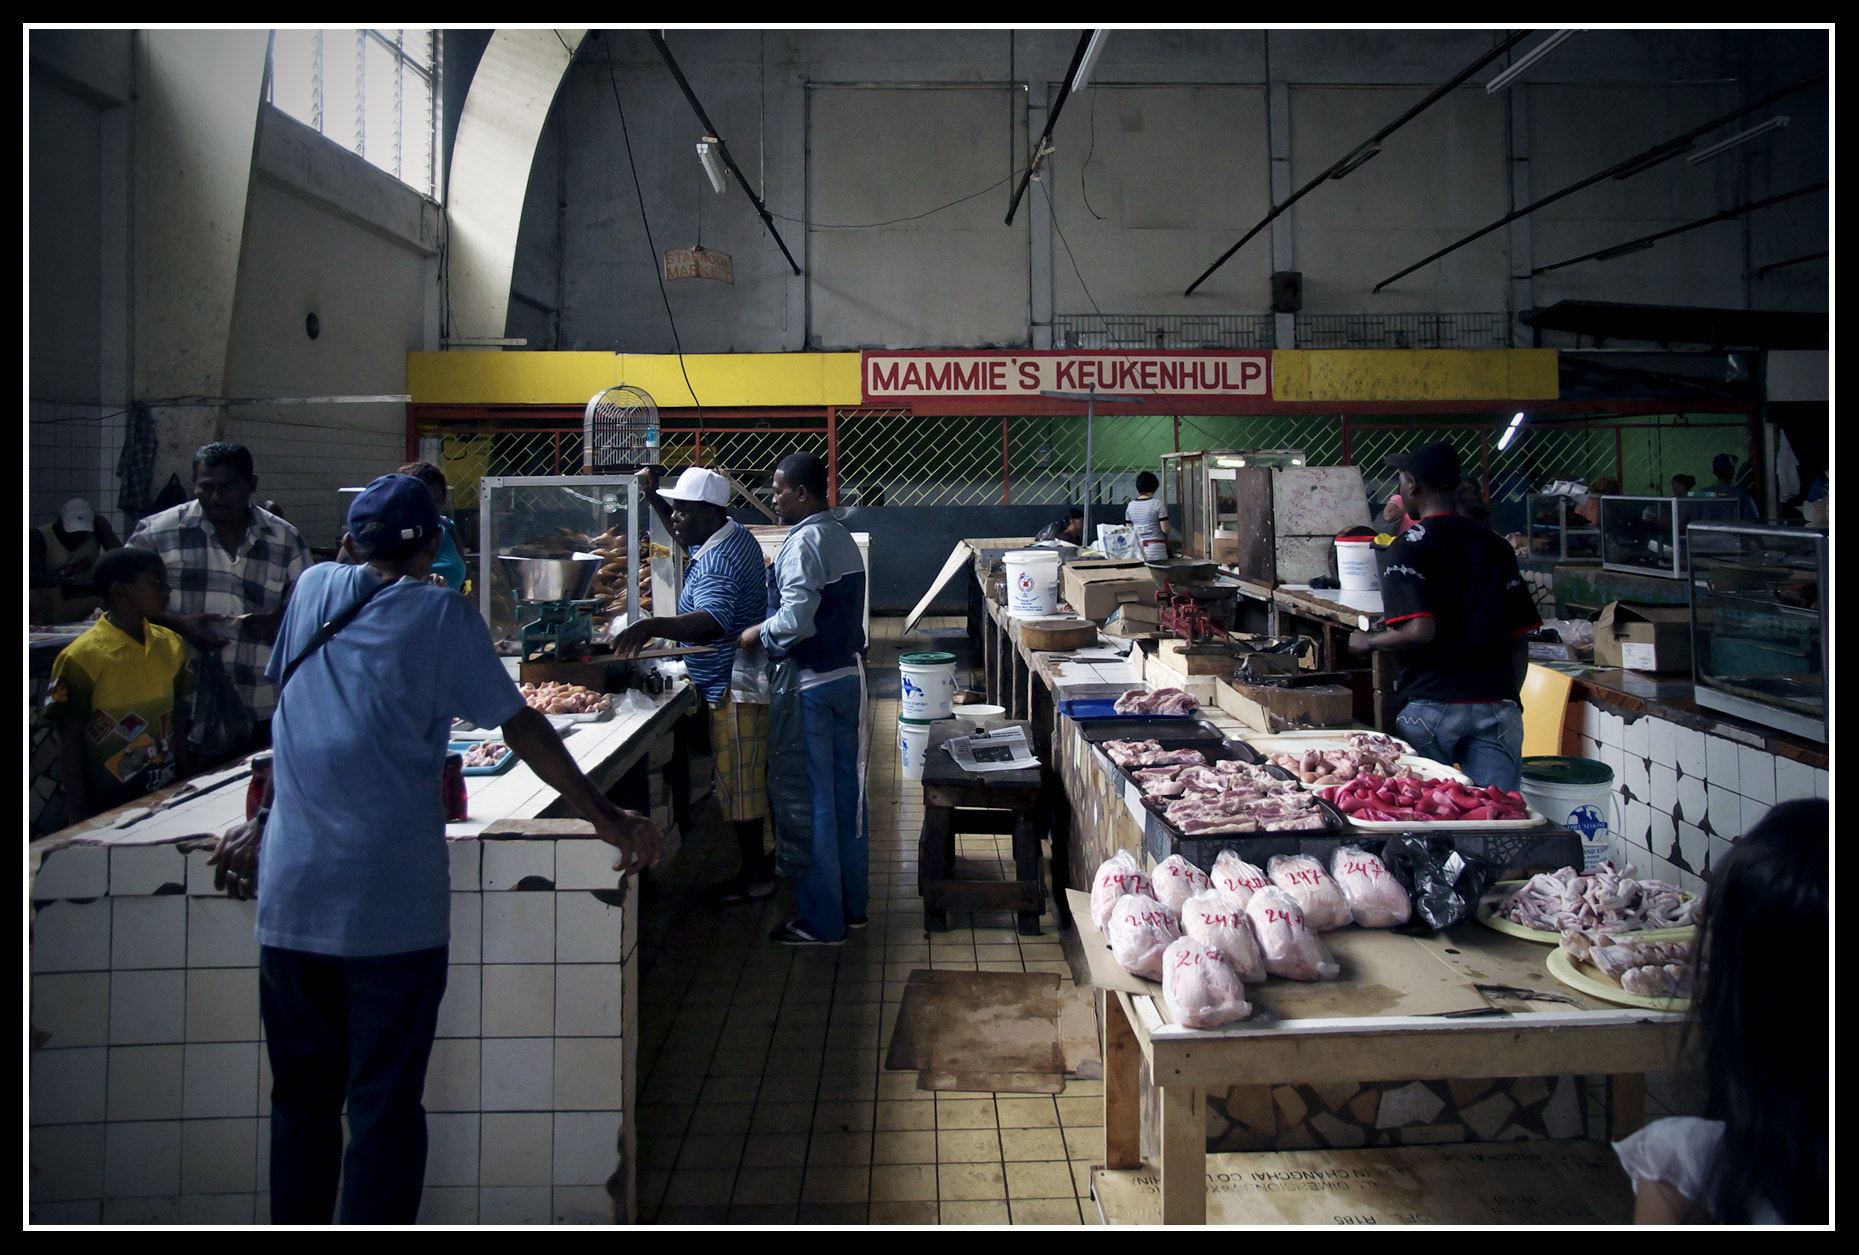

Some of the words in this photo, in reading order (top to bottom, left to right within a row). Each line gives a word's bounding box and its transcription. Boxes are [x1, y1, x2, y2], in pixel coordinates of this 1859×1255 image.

[872, 358, 1040, 391] MAMMIE'S
[1056, 360, 1262, 390] KEUKENHULP
[1285, 868, 1321, 885] 247
[1251, 1169, 1350, 1182] CHANGCHAI
